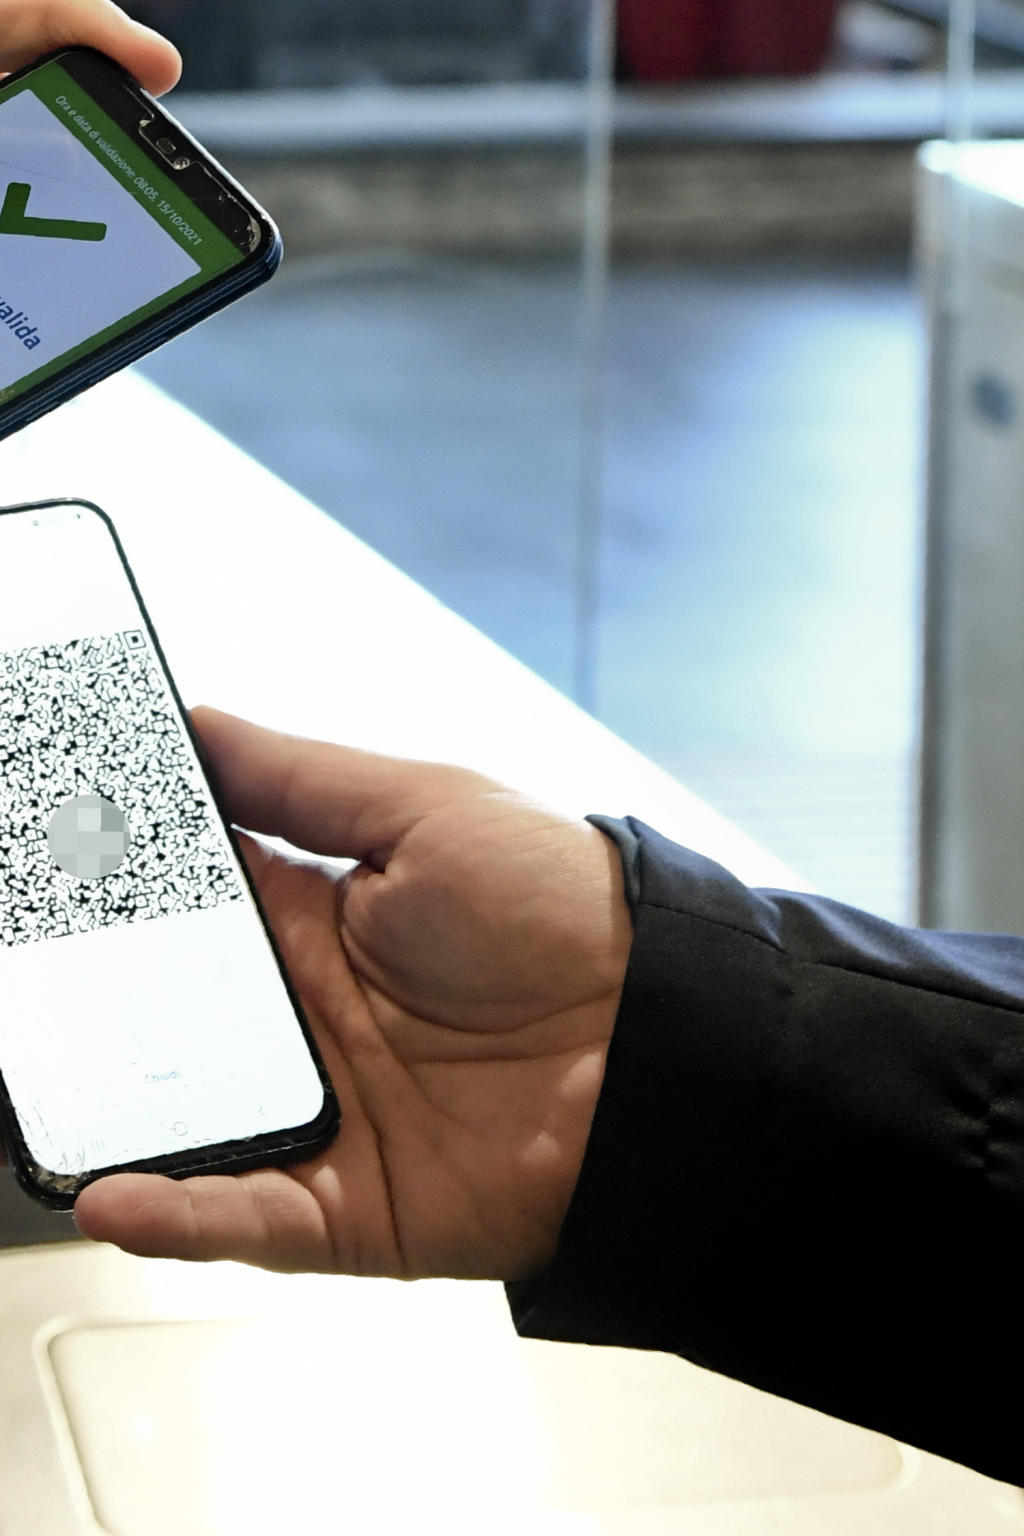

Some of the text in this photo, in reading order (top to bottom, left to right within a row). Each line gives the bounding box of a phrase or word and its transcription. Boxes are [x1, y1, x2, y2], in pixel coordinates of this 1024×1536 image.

[55, 95, 71, 111] Ora
[73, 115, 92, 133] data
[157, 200, 203, 246] 15/10/2021
